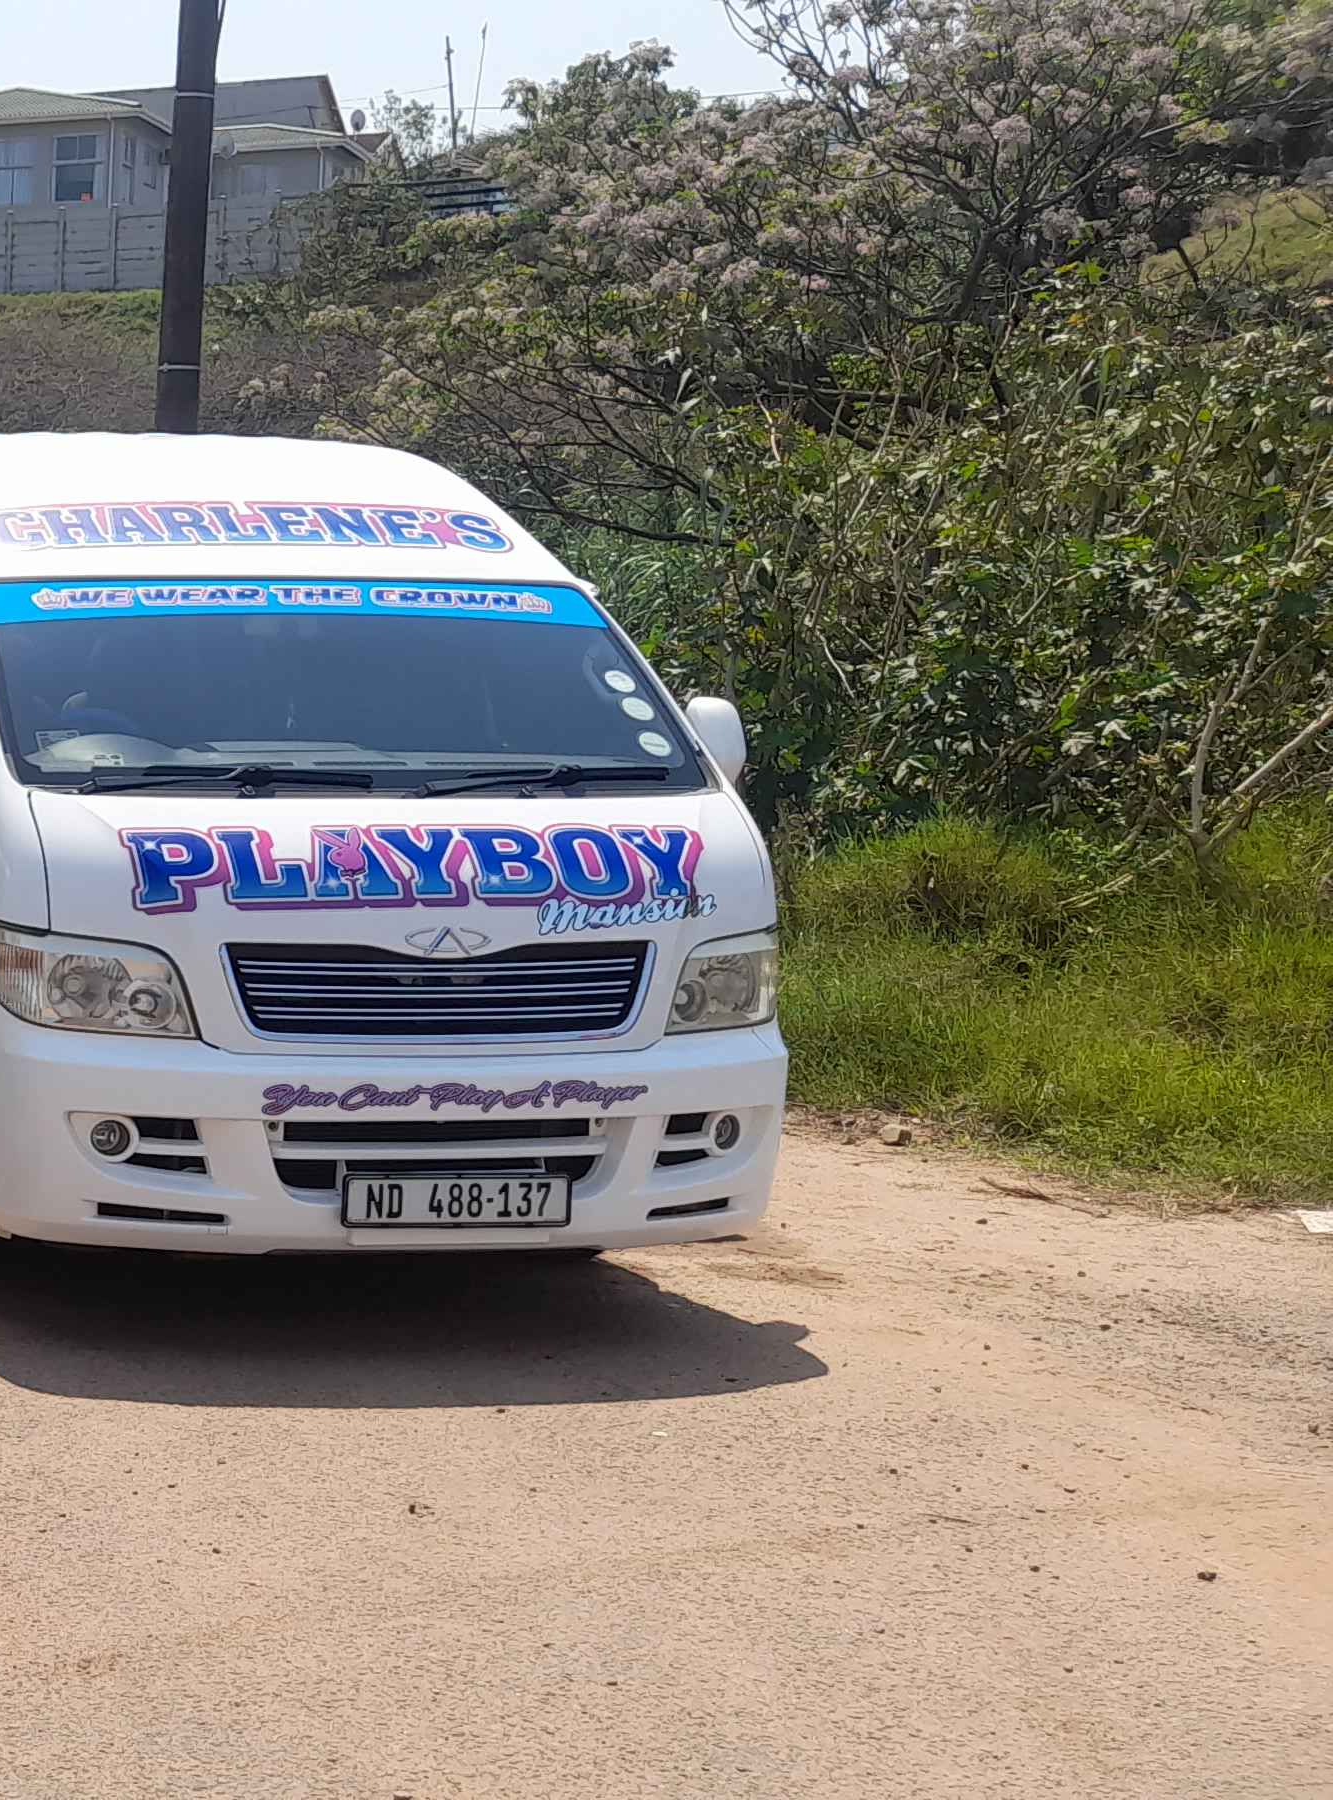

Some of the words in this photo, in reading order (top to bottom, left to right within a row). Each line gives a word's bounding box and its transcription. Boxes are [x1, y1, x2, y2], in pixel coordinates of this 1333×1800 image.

[68, 589, 133, 607] WE
[139, 586, 267, 606] WEAR
[271, 585, 361, 605] THE
[370, 587, 519, 611] CROWN
[120, 825, 705, 914] PLAYBOY
[261, 1083, 338, 1116] You
[429, 1082, 506, 1113] Play
[365, 1183, 404, 1219] ND
[428, 1181, 552, 1218] 488-137
